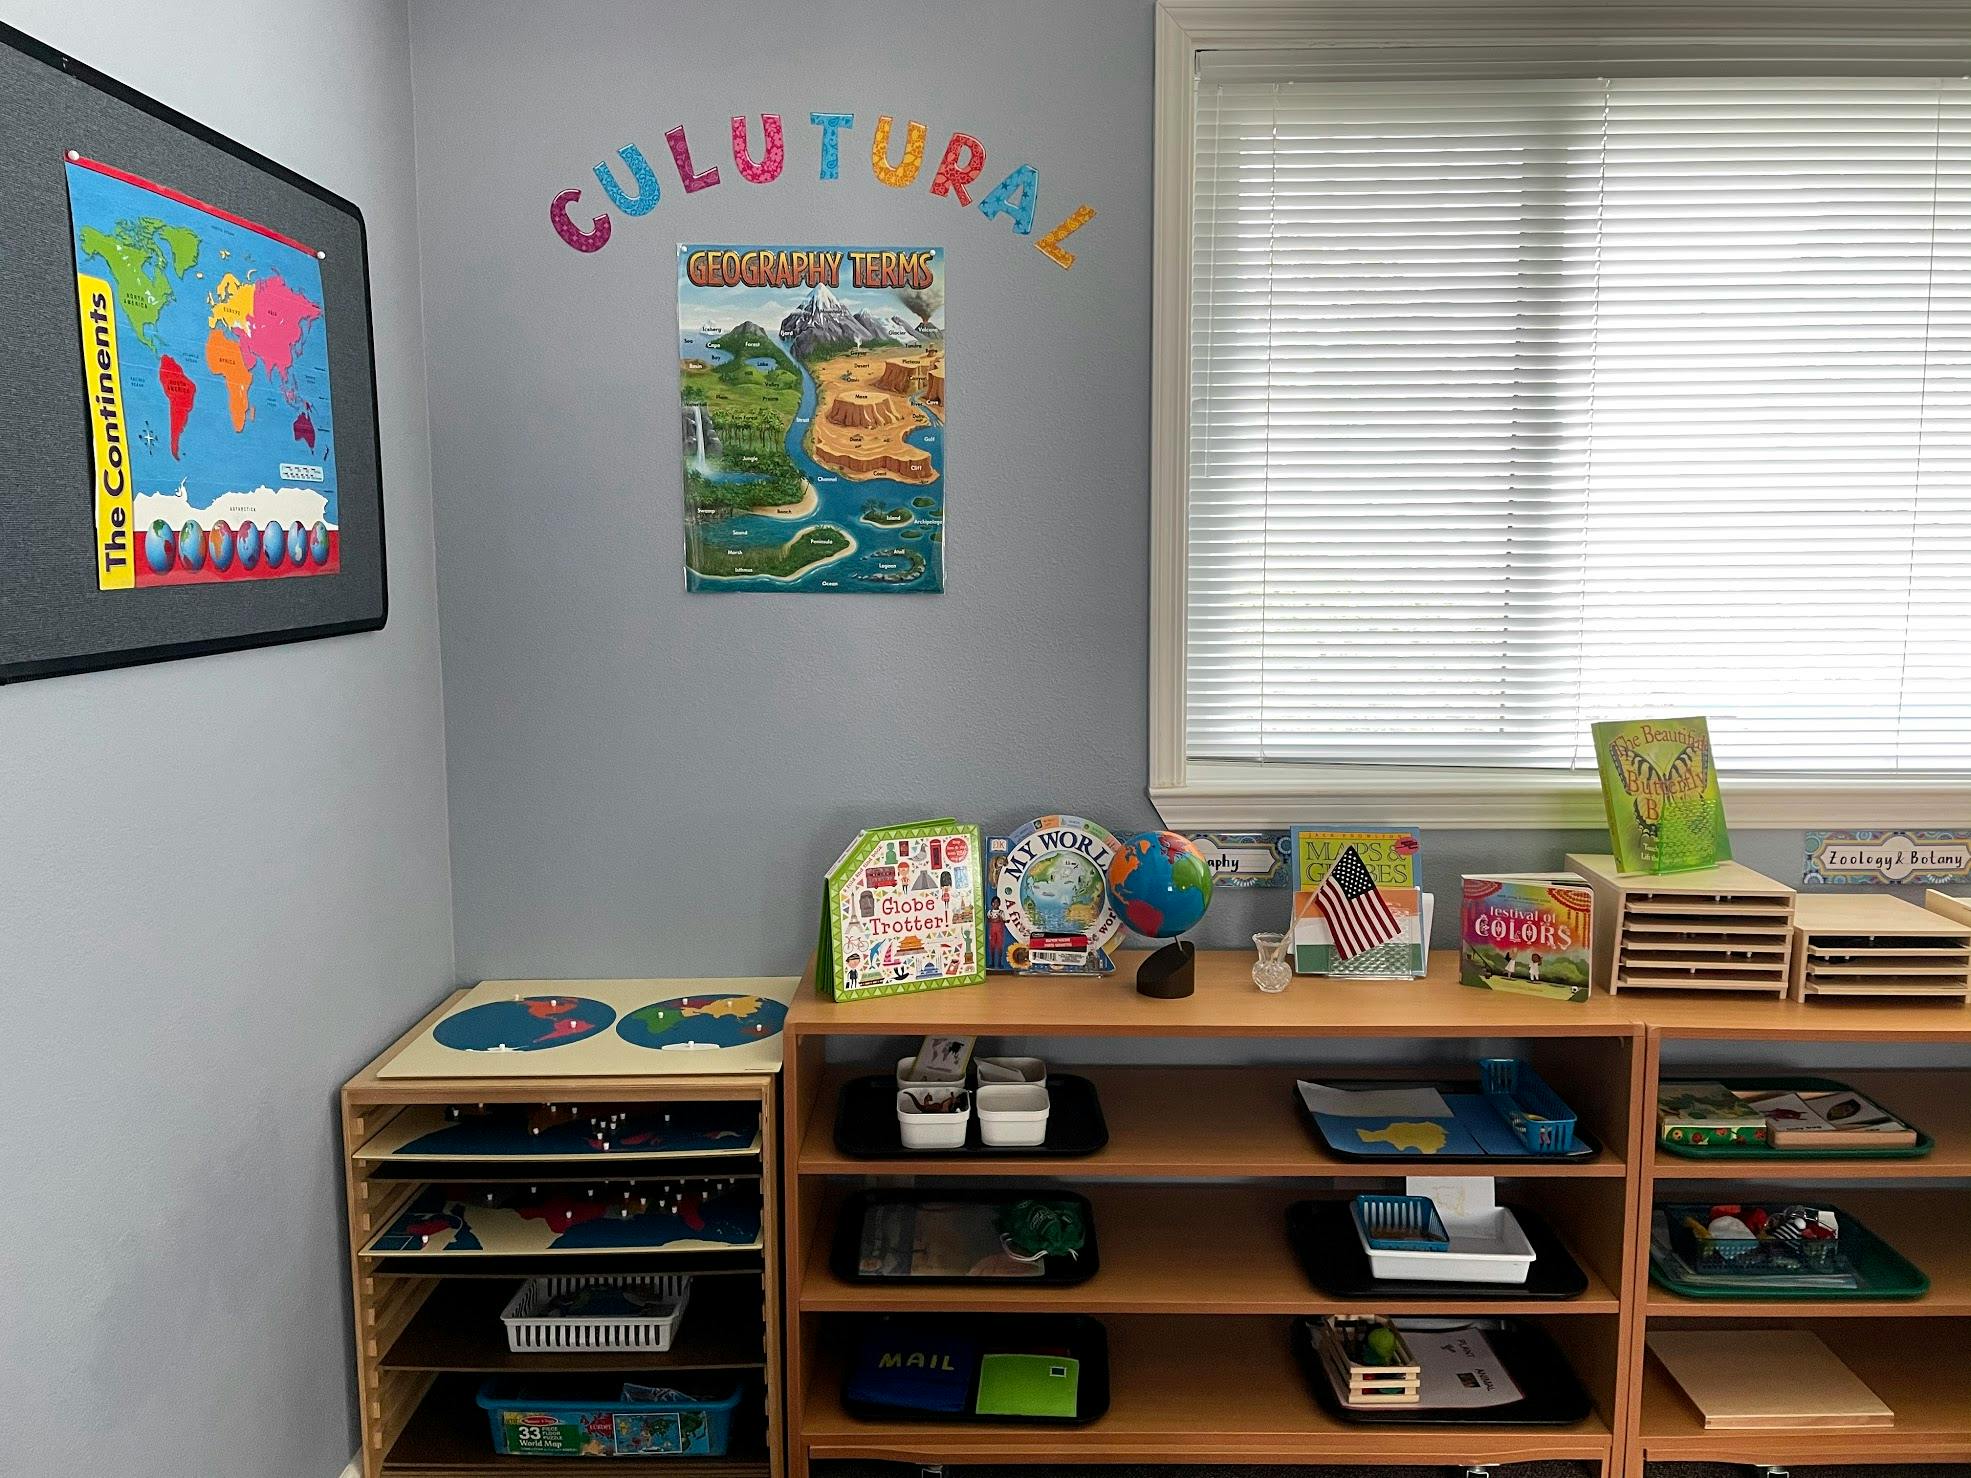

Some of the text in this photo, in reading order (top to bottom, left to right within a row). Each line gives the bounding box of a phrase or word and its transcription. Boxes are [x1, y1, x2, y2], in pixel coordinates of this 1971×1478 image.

[550, 113, 1097, 272] CULUTURAL
[687, 250, 934, 289] GEOGRAPHY TERMS
[89, 292, 127, 573] The Continents
[1612, 724, 1708, 758] The Beautiful
[1627, 766, 1705, 797] Butterfly
[1003, 840, 1038, 882] MY
[1037, 830, 1110, 874] WORL
[1206, 853, 1240, 873] aphy
[1829, 850, 1893, 871] Zoology
[1910, 850, 1963, 868] Botany
[882, 896, 935, 915] Globe
[1490, 906, 1556, 924] festival of
[869, 911, 949, 936] Trotter!
[1475, 914, 1572, 950] COLORS
[878, 1352, 955, 1371] MAIL
[519, 1426, 542, 1440] 33
[519, 1439, 543, 1448] World
[543, 1440, 562, 1449] Map
